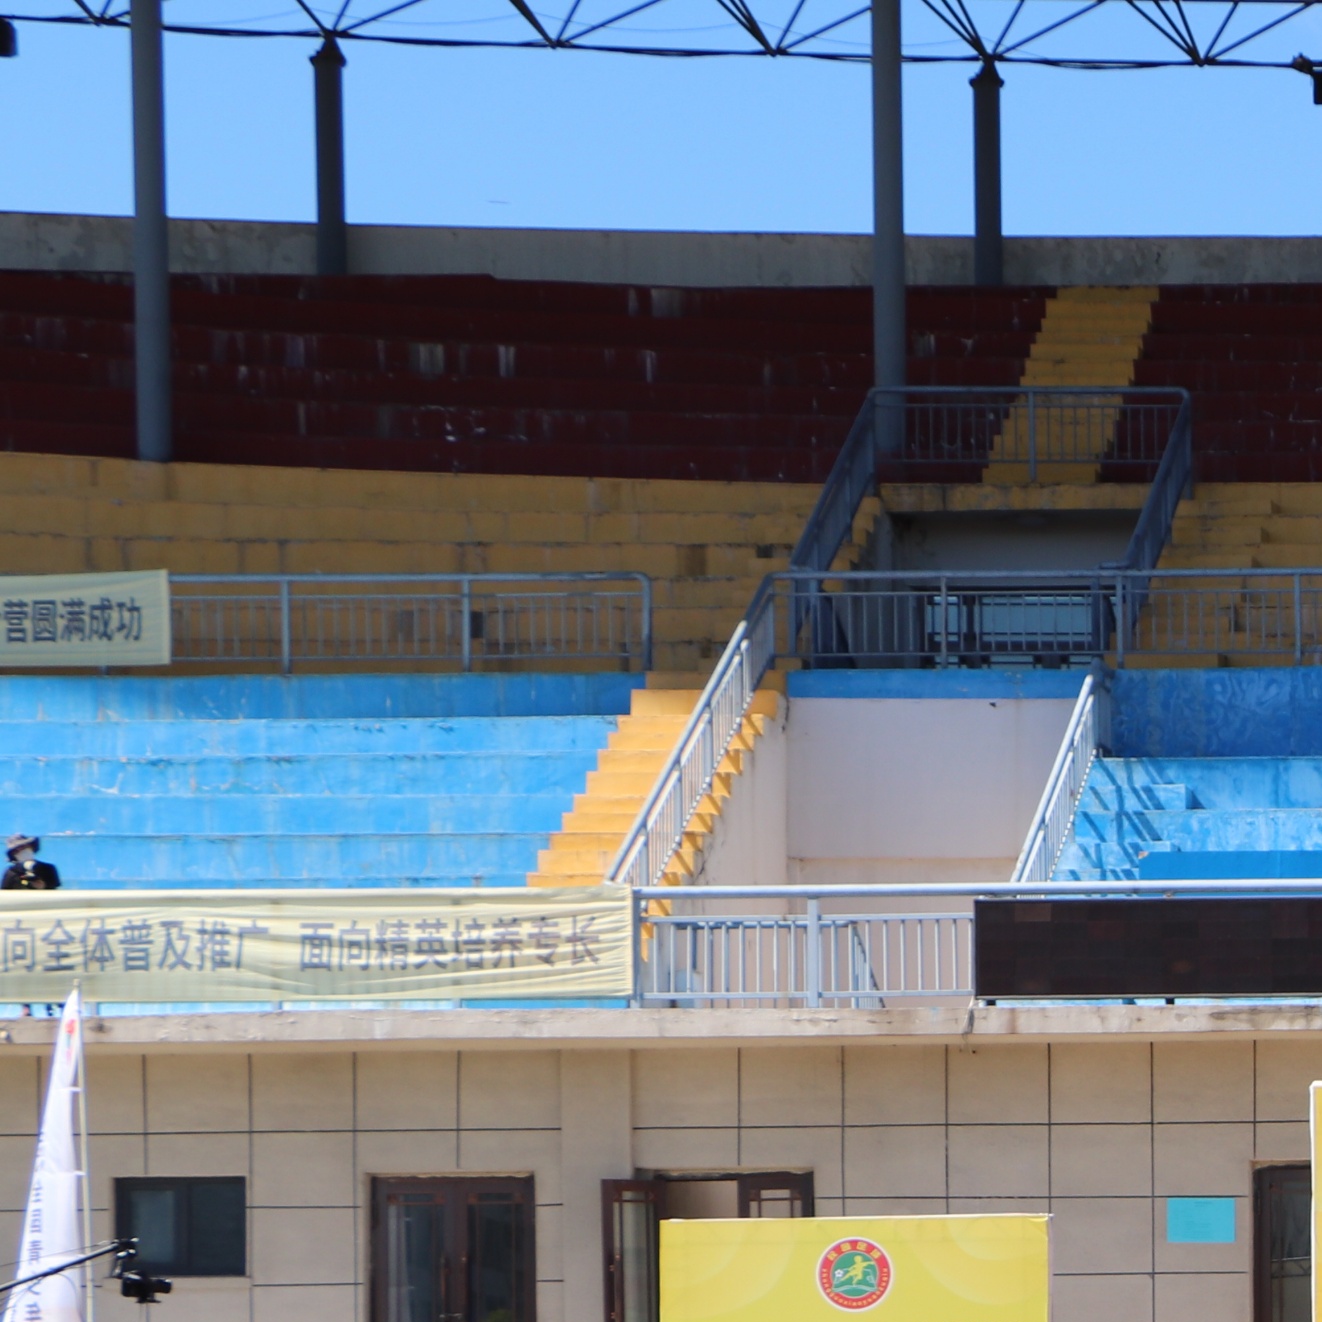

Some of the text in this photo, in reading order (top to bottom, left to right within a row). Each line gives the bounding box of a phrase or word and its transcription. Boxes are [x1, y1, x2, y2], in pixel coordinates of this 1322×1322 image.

[300, 917, 600, 971] 面向精英培养专长
